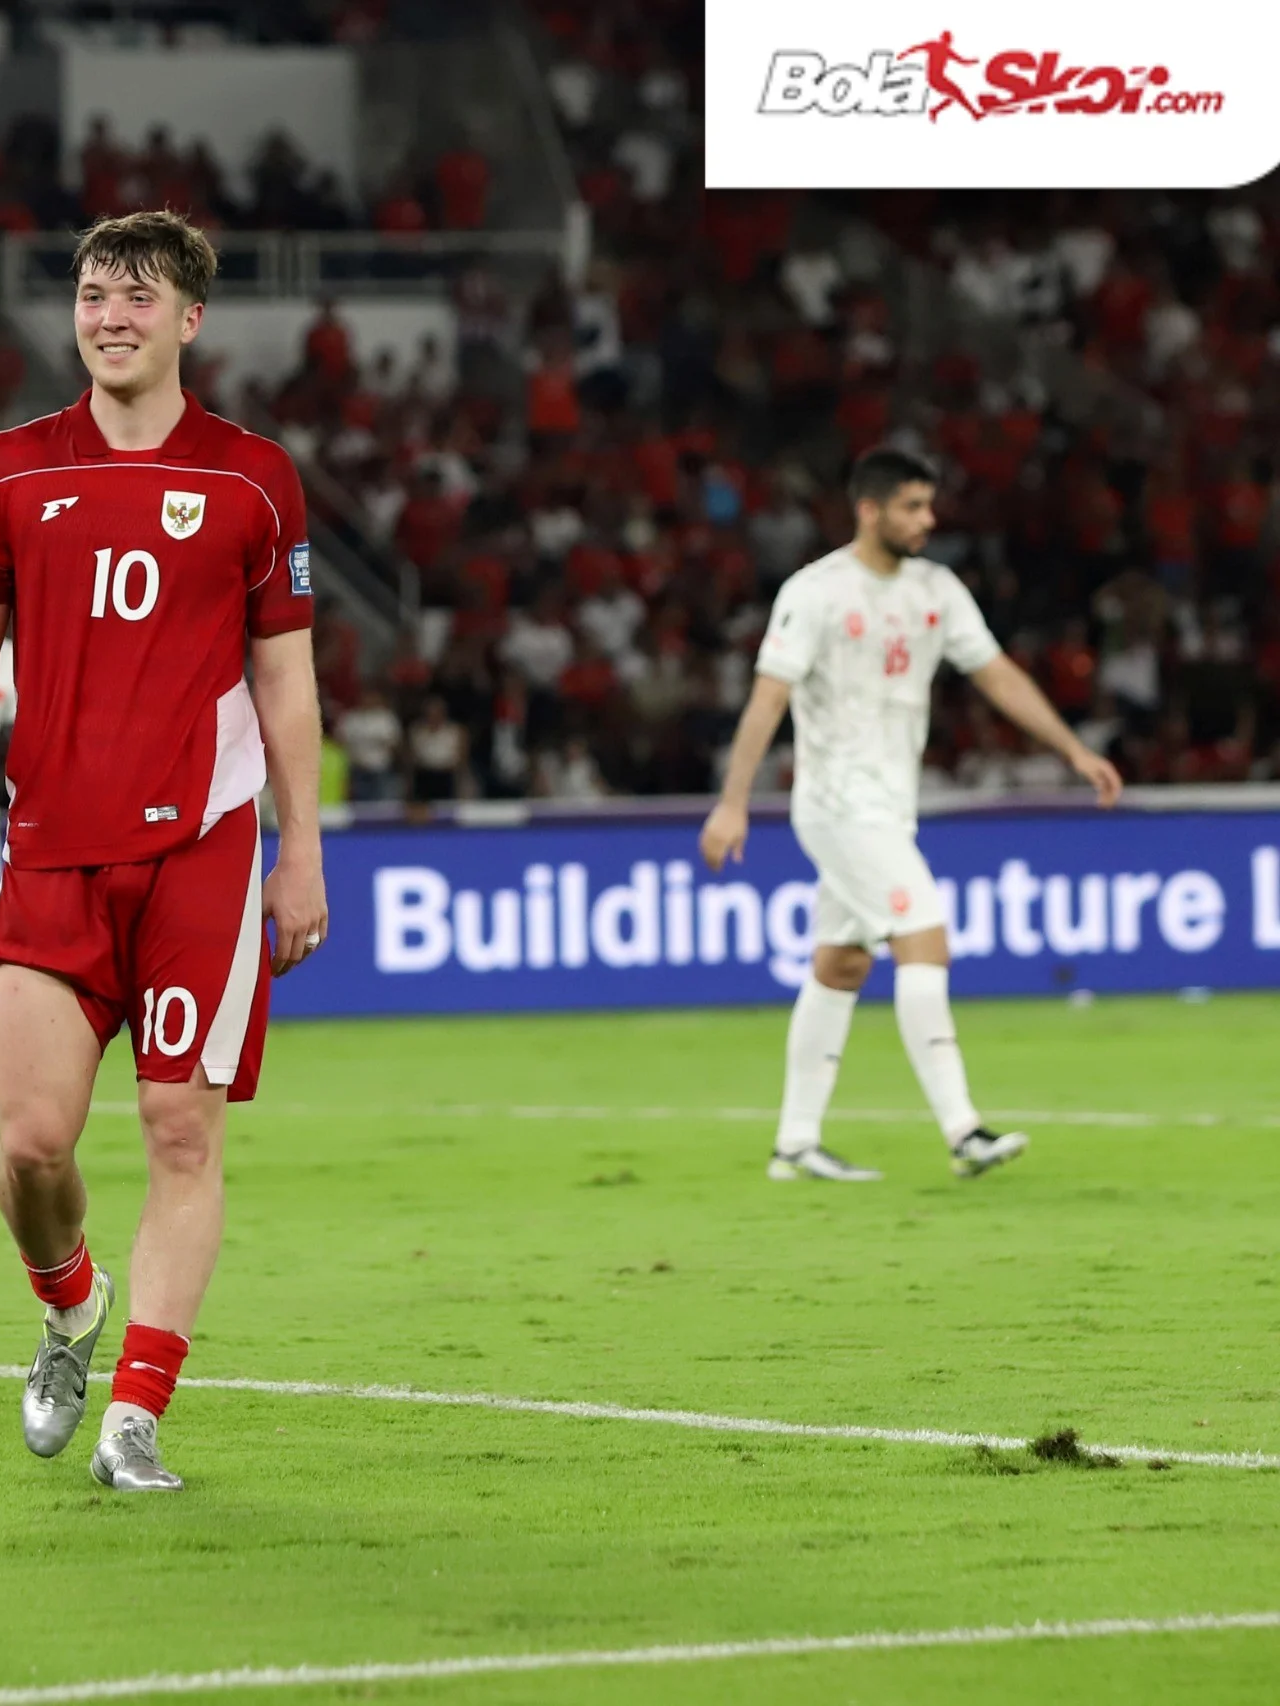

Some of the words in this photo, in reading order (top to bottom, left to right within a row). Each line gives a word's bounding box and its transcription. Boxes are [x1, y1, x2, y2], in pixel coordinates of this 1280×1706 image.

[90, 547, 160, 621] 10
[374, 860, 820, 987] Building
[938, 858, 1227, 956] uture
[141, 986, 198, 1057] 10
